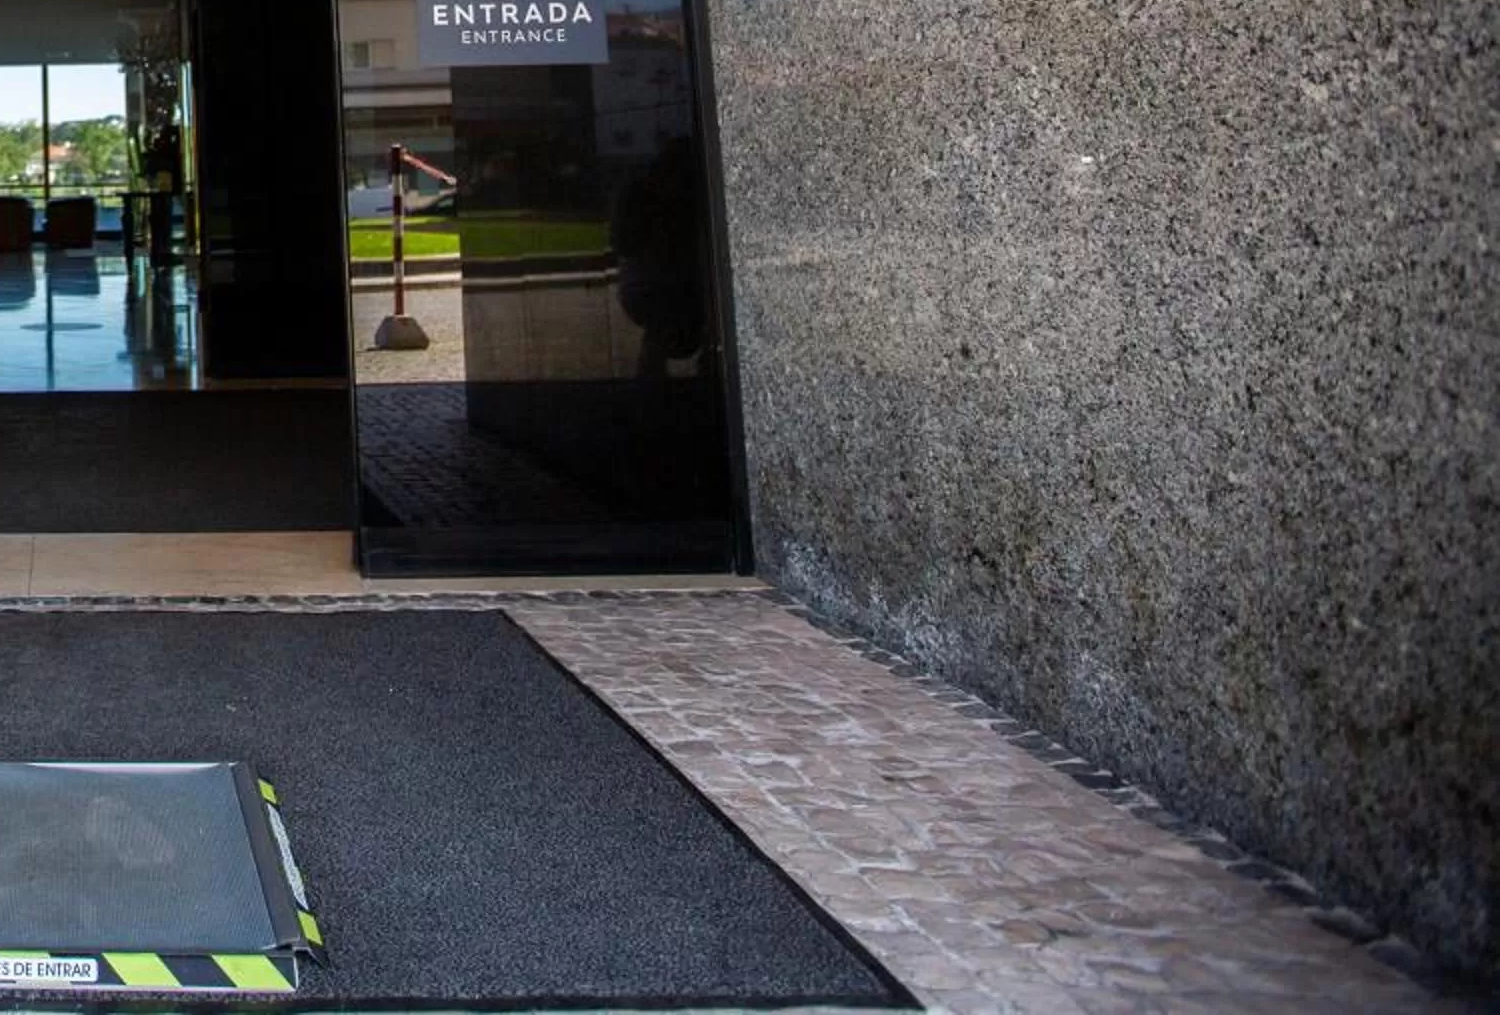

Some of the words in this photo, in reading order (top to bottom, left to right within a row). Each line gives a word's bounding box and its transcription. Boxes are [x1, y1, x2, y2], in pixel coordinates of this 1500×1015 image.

[432, 1, 593, 26] ENTRADA
[460, 28, 567, 44] ENTRANCE
[13, 962, 32, 977] DE
[37, 962, 92, 978] ENTRAR
